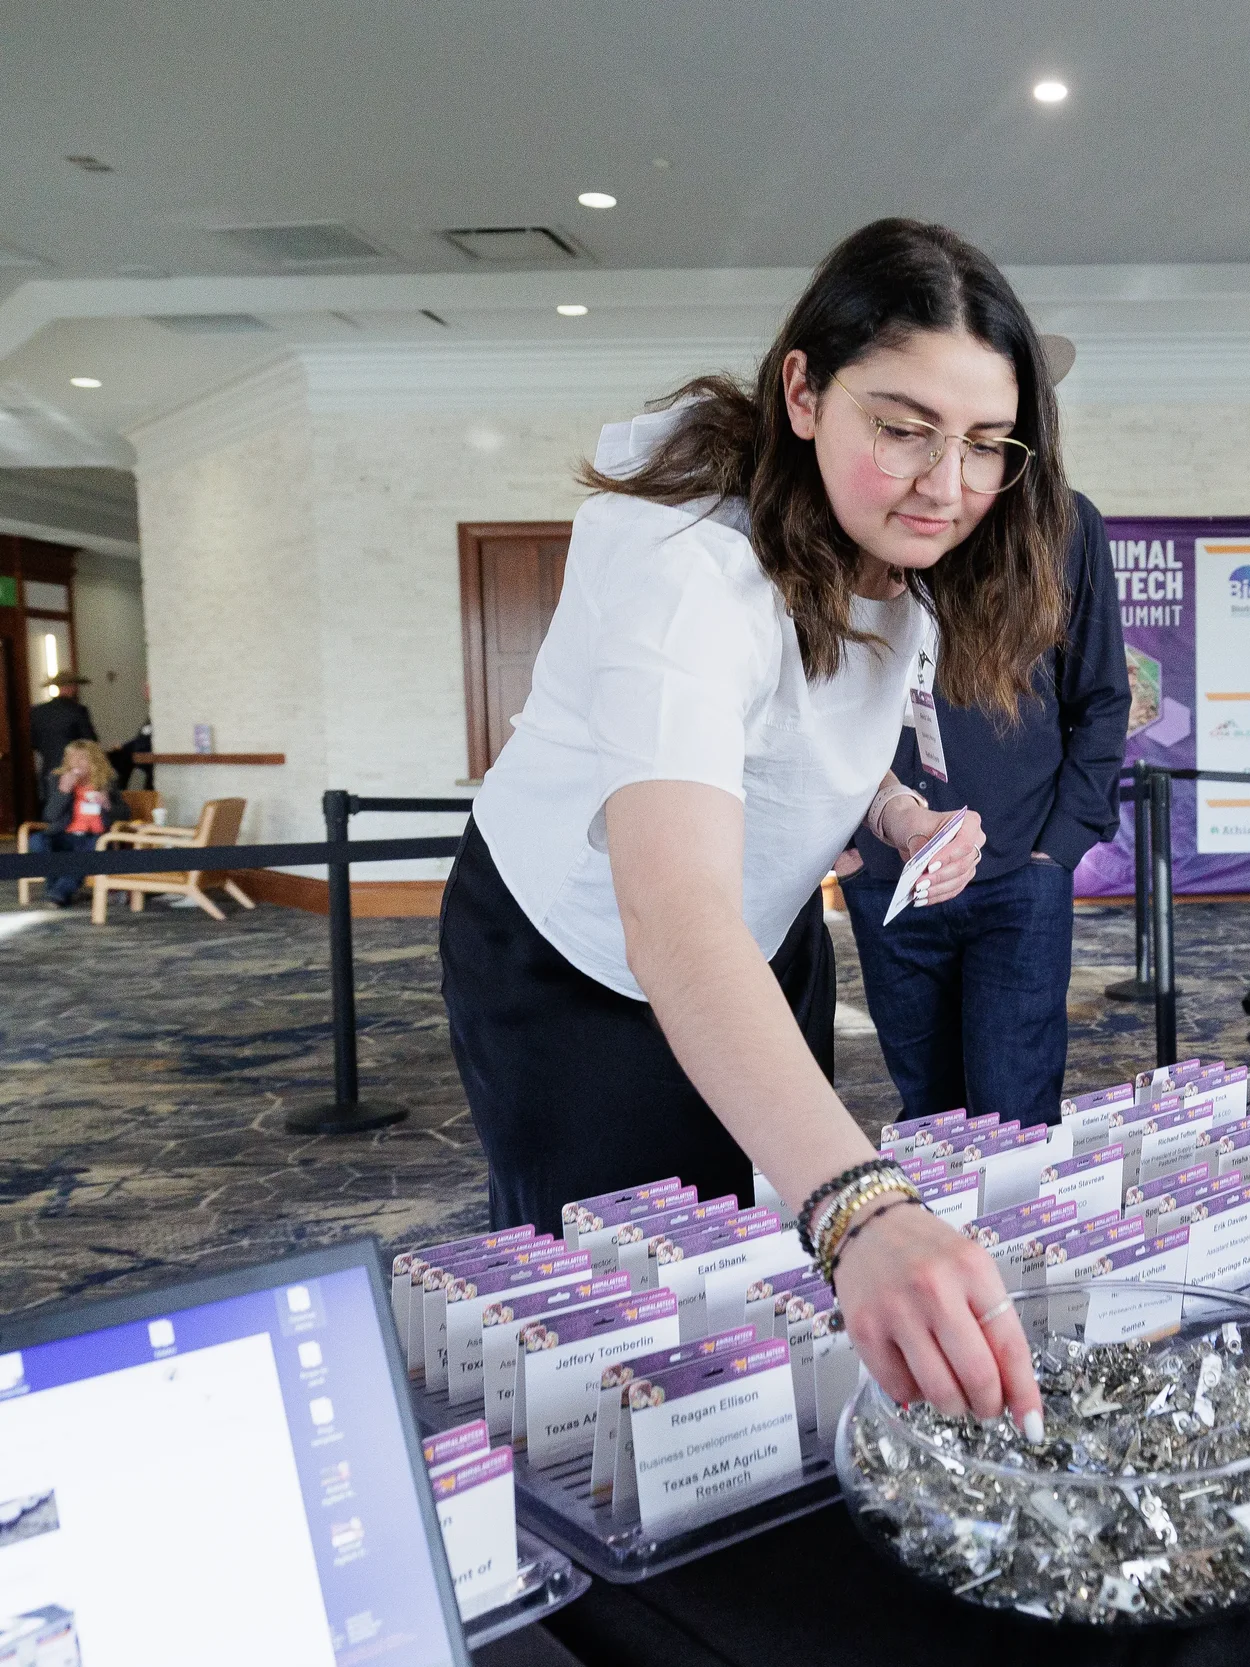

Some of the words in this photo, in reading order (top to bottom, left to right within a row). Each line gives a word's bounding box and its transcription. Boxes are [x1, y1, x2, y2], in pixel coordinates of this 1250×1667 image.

[1109, 540, 1183, 570] IMAL
[1114, 571, 1183, 601] TECH
[1121, 605, 1183, 627] UMMIT
[678, 1295, 698, 1307] enior
[555, 1351, 596, 1371] Jeffery
[599, 1336, 655, 1358] Tomberlin
[671, 1402, 717, 1428] Reagan
[719, 1391, 760, 1412] Ellison
[545, 1416, 580, 1437] Texas
[639, 1451, 684, 1473] Business
[687, 1429, 748, 1457] Development
[750, 1412, 793, 1435] Associate
[663, 1472, 699, 1494] Texas
[703, 1459, 730, 1480] A&M
[733, 1444, 778, 1470] AgriLife
[696, 1470, 752, 1500] Research
